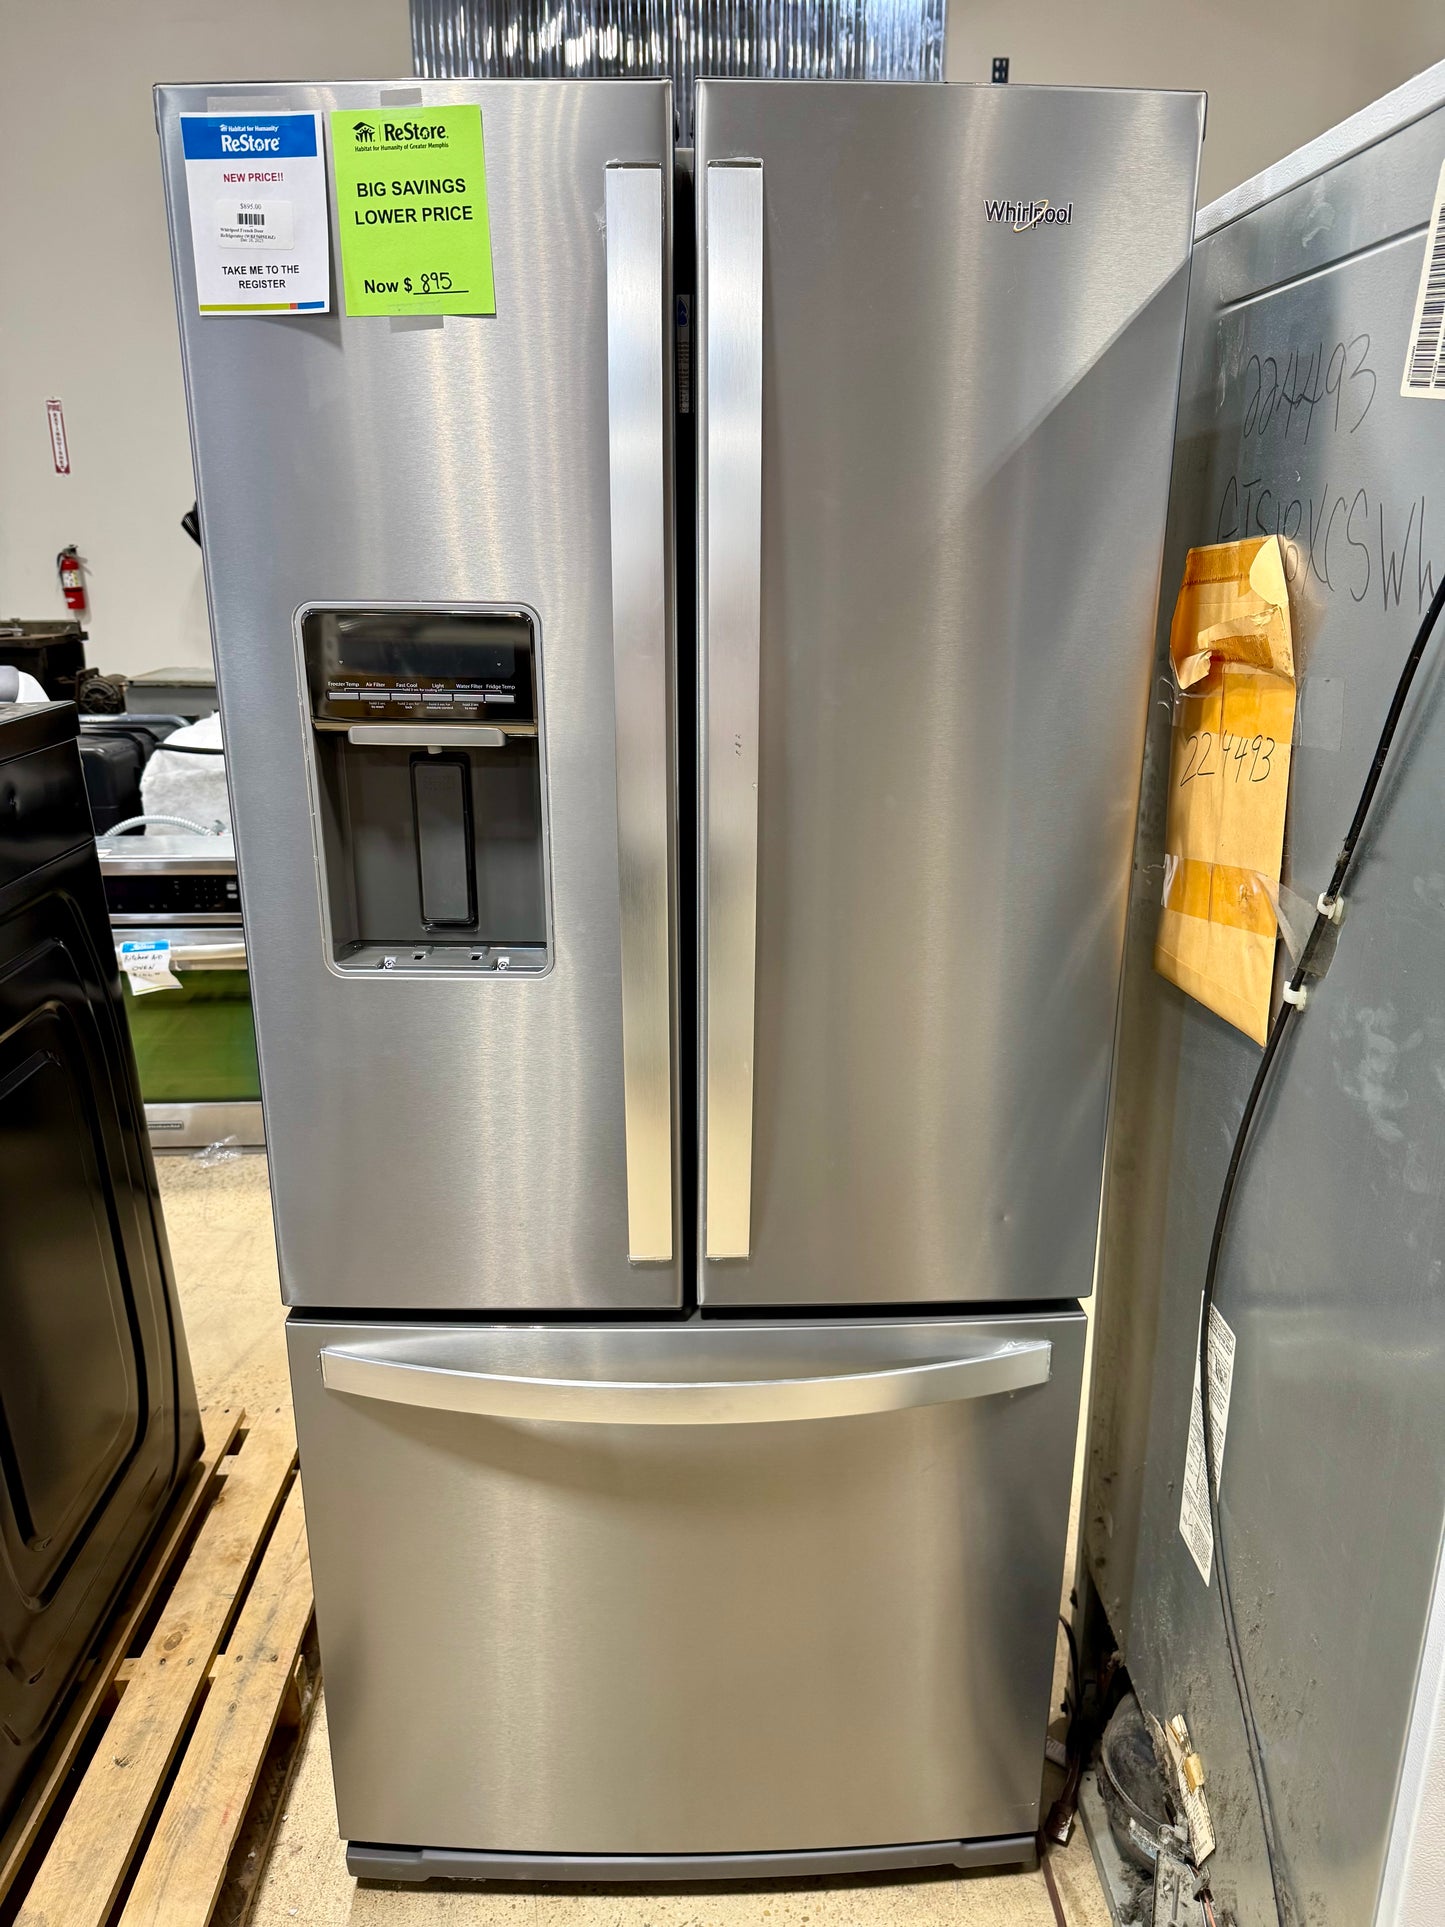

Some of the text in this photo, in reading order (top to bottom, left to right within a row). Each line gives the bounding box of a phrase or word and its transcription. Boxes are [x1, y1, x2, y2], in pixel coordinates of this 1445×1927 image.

[384, 122, 446, 141] ReStore
[221, 134, 280, 152] ReStore
[428, 142, 449, 150] Memphis
[223, 172, 284, 182] NEW PRICE!!
[356, 178, 466, 197] BIG SAVINGS
[354, 205, 473, 225] LOWER PRICE
[983, 199, 1074, 231] Whirlpool
[222, 264, 300, 275] TAKE ME TO THE
[238, 279, 286, 289] REGISTER
[364, 272, 453, 294] Now $ 895
[1243, 333, 1377, 445] 224493
[1179, 729, 1276, 787] 224493
